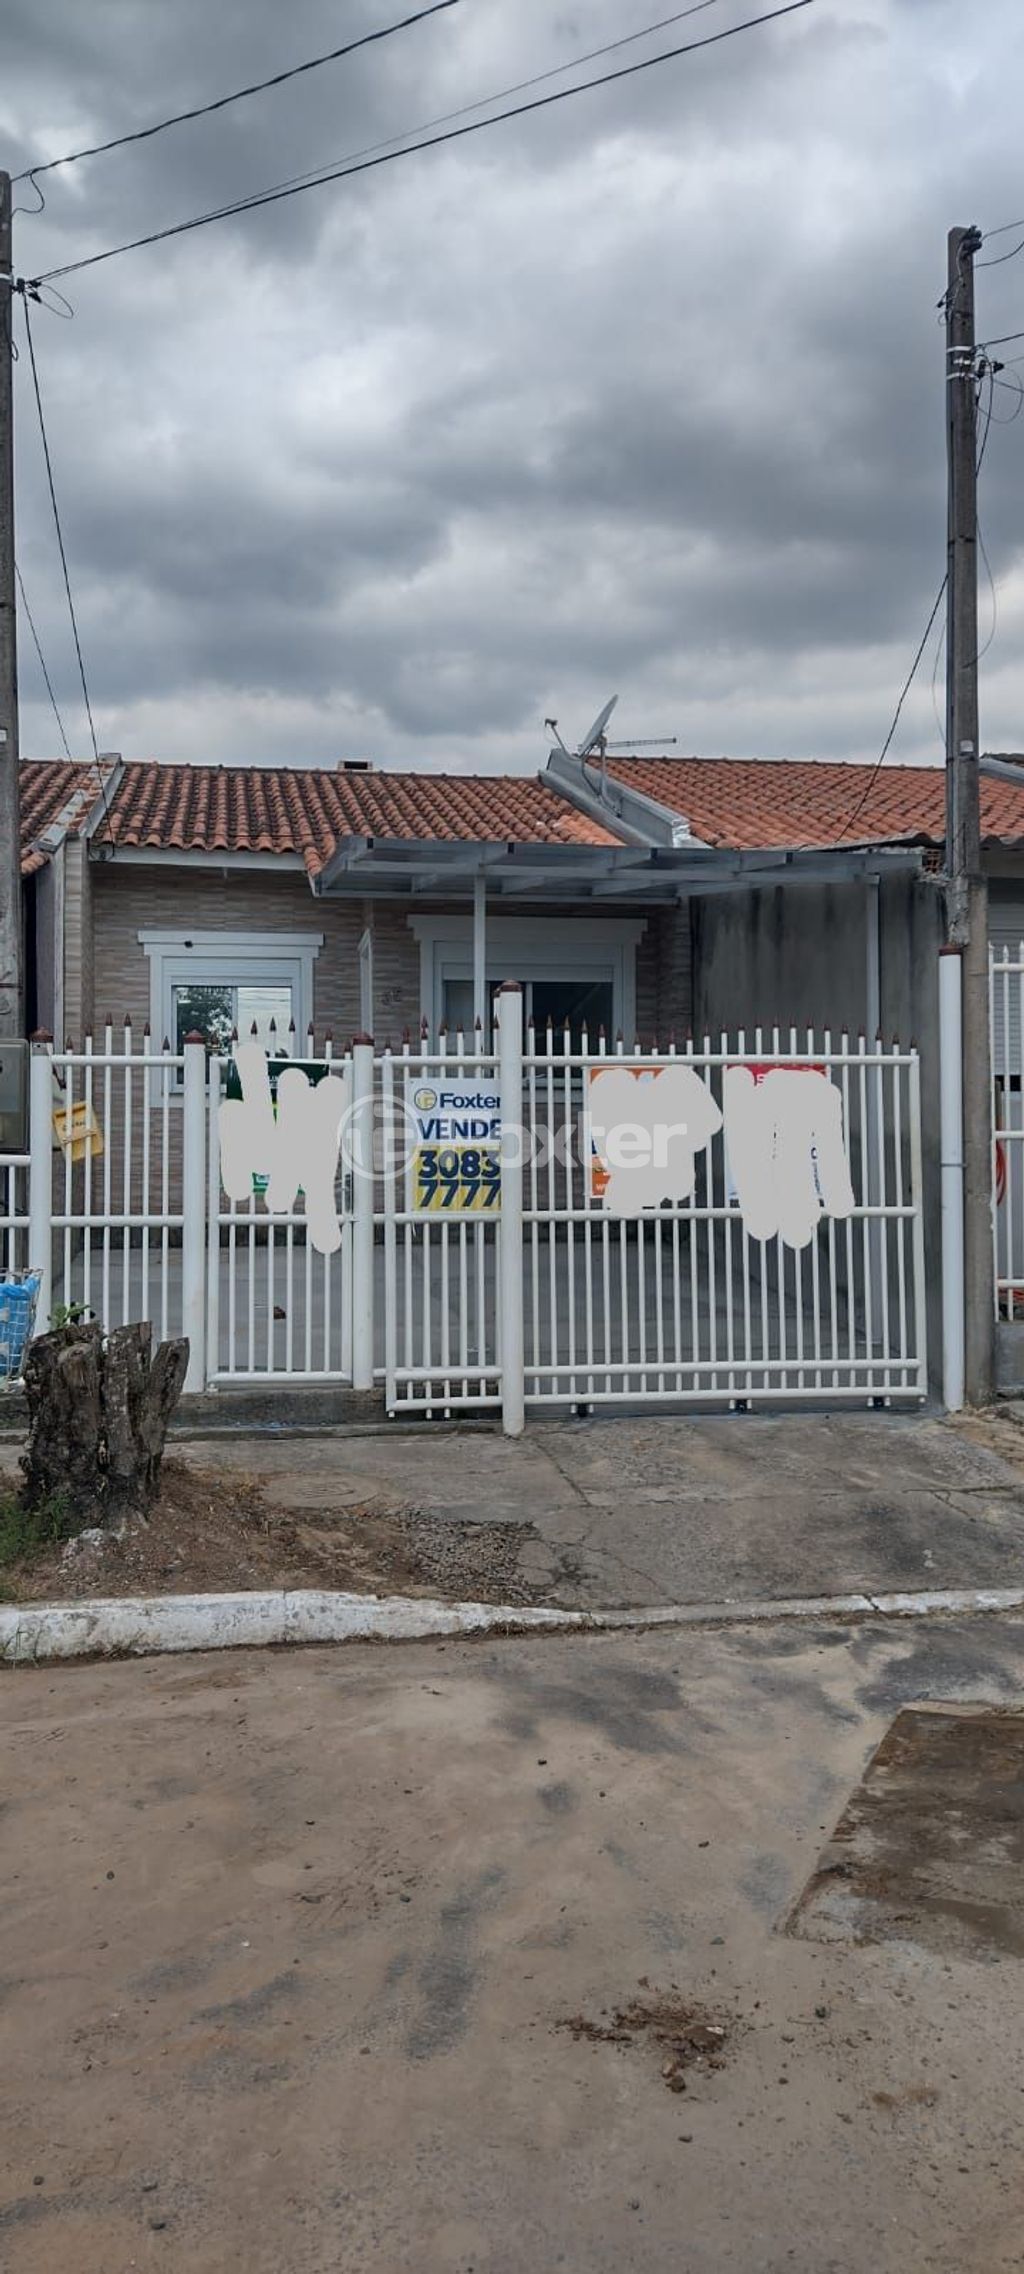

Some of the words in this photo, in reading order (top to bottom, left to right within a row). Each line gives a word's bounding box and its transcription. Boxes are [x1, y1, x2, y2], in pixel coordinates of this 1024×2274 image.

[417, 1118, 502, 1140] VENDE
[418, 1149, 501, 1179] 3083
[418, 1179, 502, 1207] 7777
